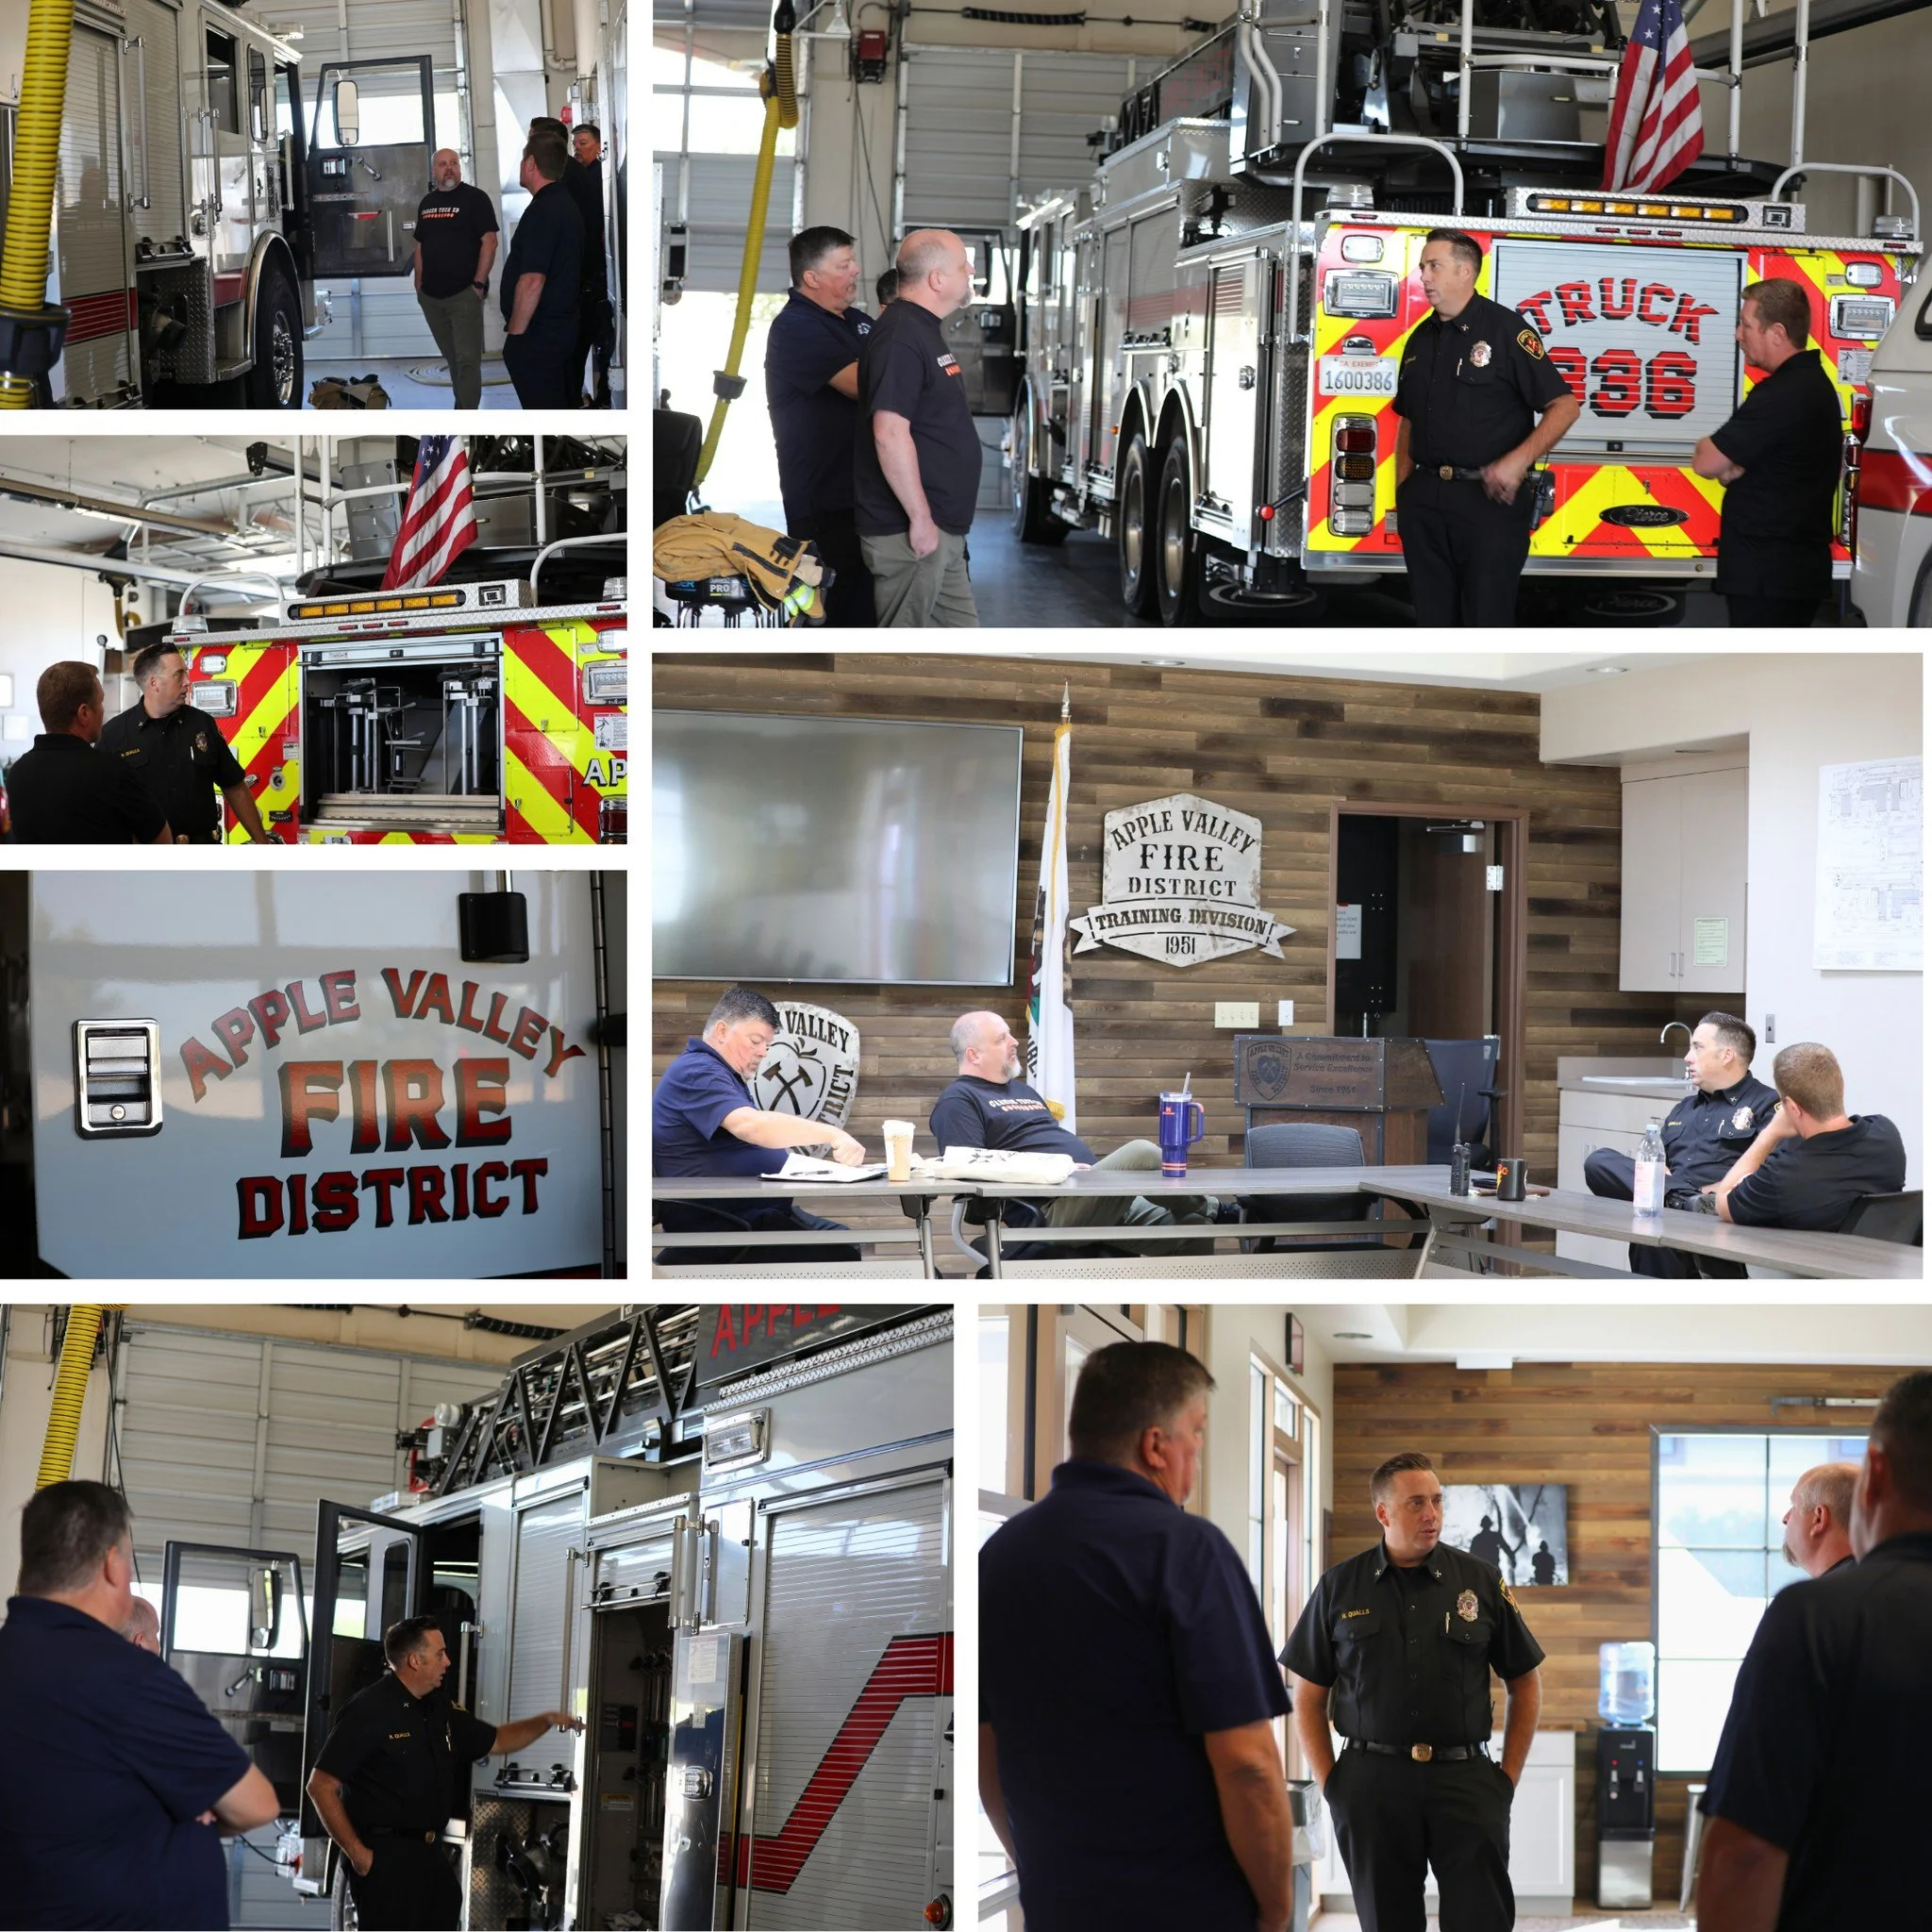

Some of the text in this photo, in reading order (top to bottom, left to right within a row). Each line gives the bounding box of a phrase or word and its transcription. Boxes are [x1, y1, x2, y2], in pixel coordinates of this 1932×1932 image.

[1516, 277, 1720, 345] TRUCK
[1324, 370, 1393, 391] 1600386
[709, 584, 730, 593] PRO
[1110, 809, 1257, 855] APPLE VALLEY
[1140, 843, 1224, 873] FIRE
[1128, 876, 1237, 897] DISTRICT
[1095, 907, 1268, 935] TRAINING DIVISION
[1165, 935, 1196, 955] 1951
[179, 968, 587, 1104] APPLE VALLEY
[785, 1010, 849, 1054] VALLEY
[1293, 1063, 1374, 1074] Service Excellence
[1306, 1052, 1358, 1061] Commitment
[816, 1064, 854, 1126] TRICT
[1309, 1084, 1357, 1094] Since 1951
[277, 1058, 512, 1158] FIRE
[236, 1158, 549, 1241] DISTRICT
[1347, 1608, 1371, 1618] QUALLS
